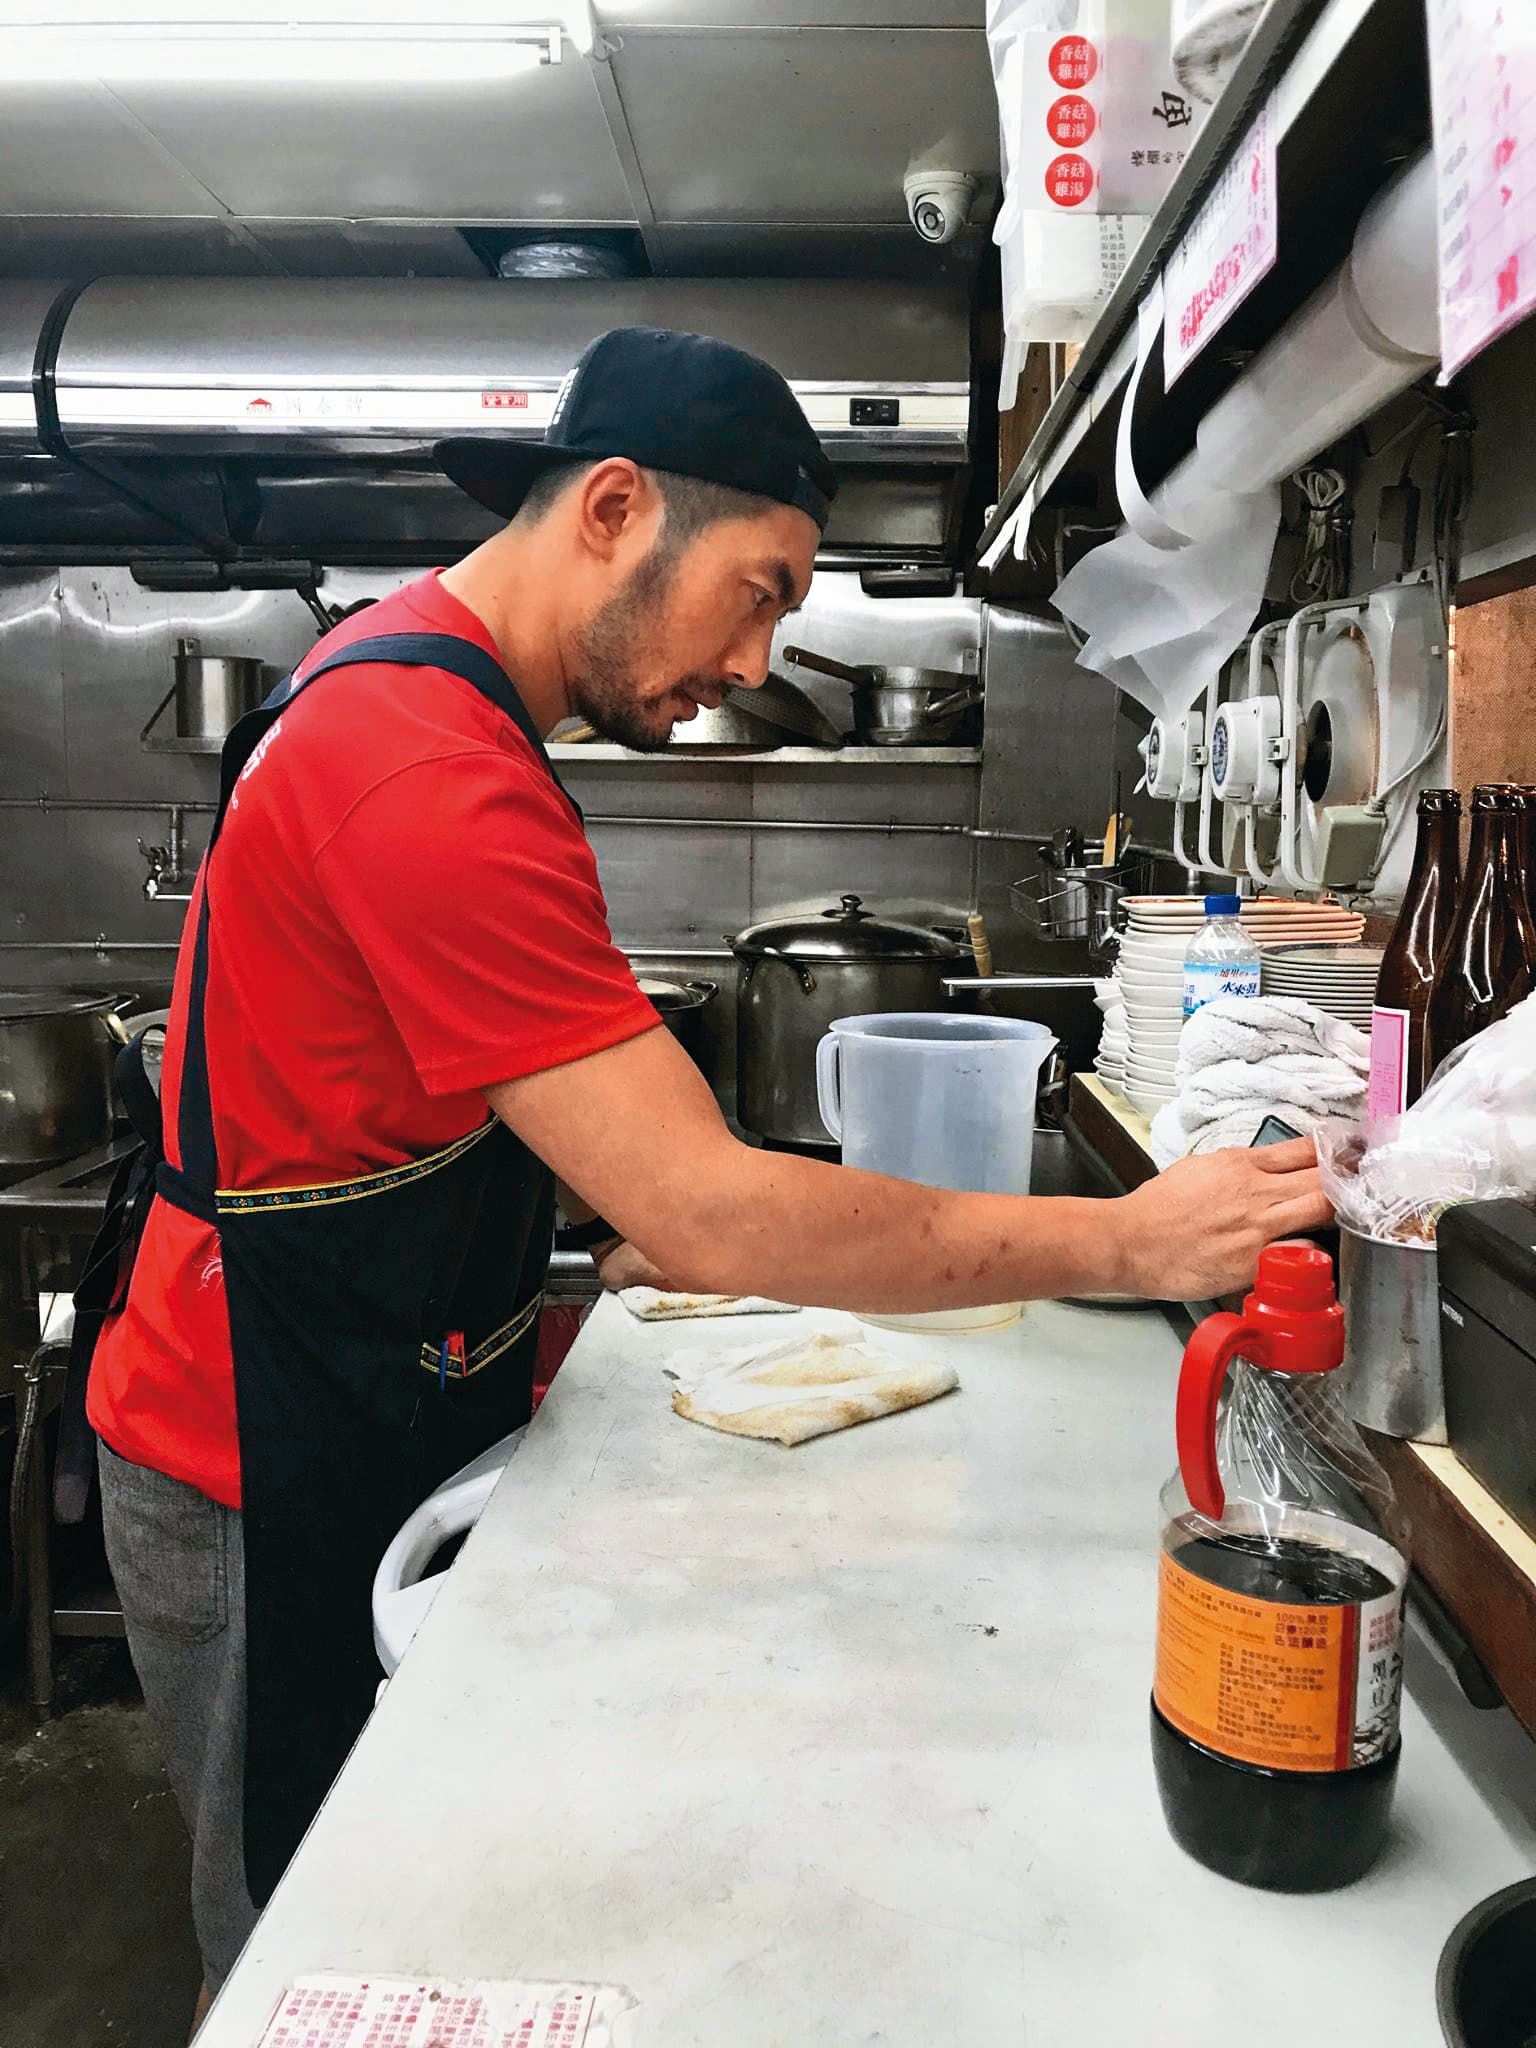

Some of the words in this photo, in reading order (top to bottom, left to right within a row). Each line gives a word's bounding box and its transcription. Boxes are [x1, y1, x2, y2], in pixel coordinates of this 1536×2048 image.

[1059, 45, 1089, 61] 香菇
[1058, 64, 1088, 80] 雞湯
[1057, 104, 1087, 120] 香菇
[1056, 123, 1087, 139] 雞湯
[1056, 163, 1086, 179] 香菇
[1055, 181, 1085, 198] 雞湯
